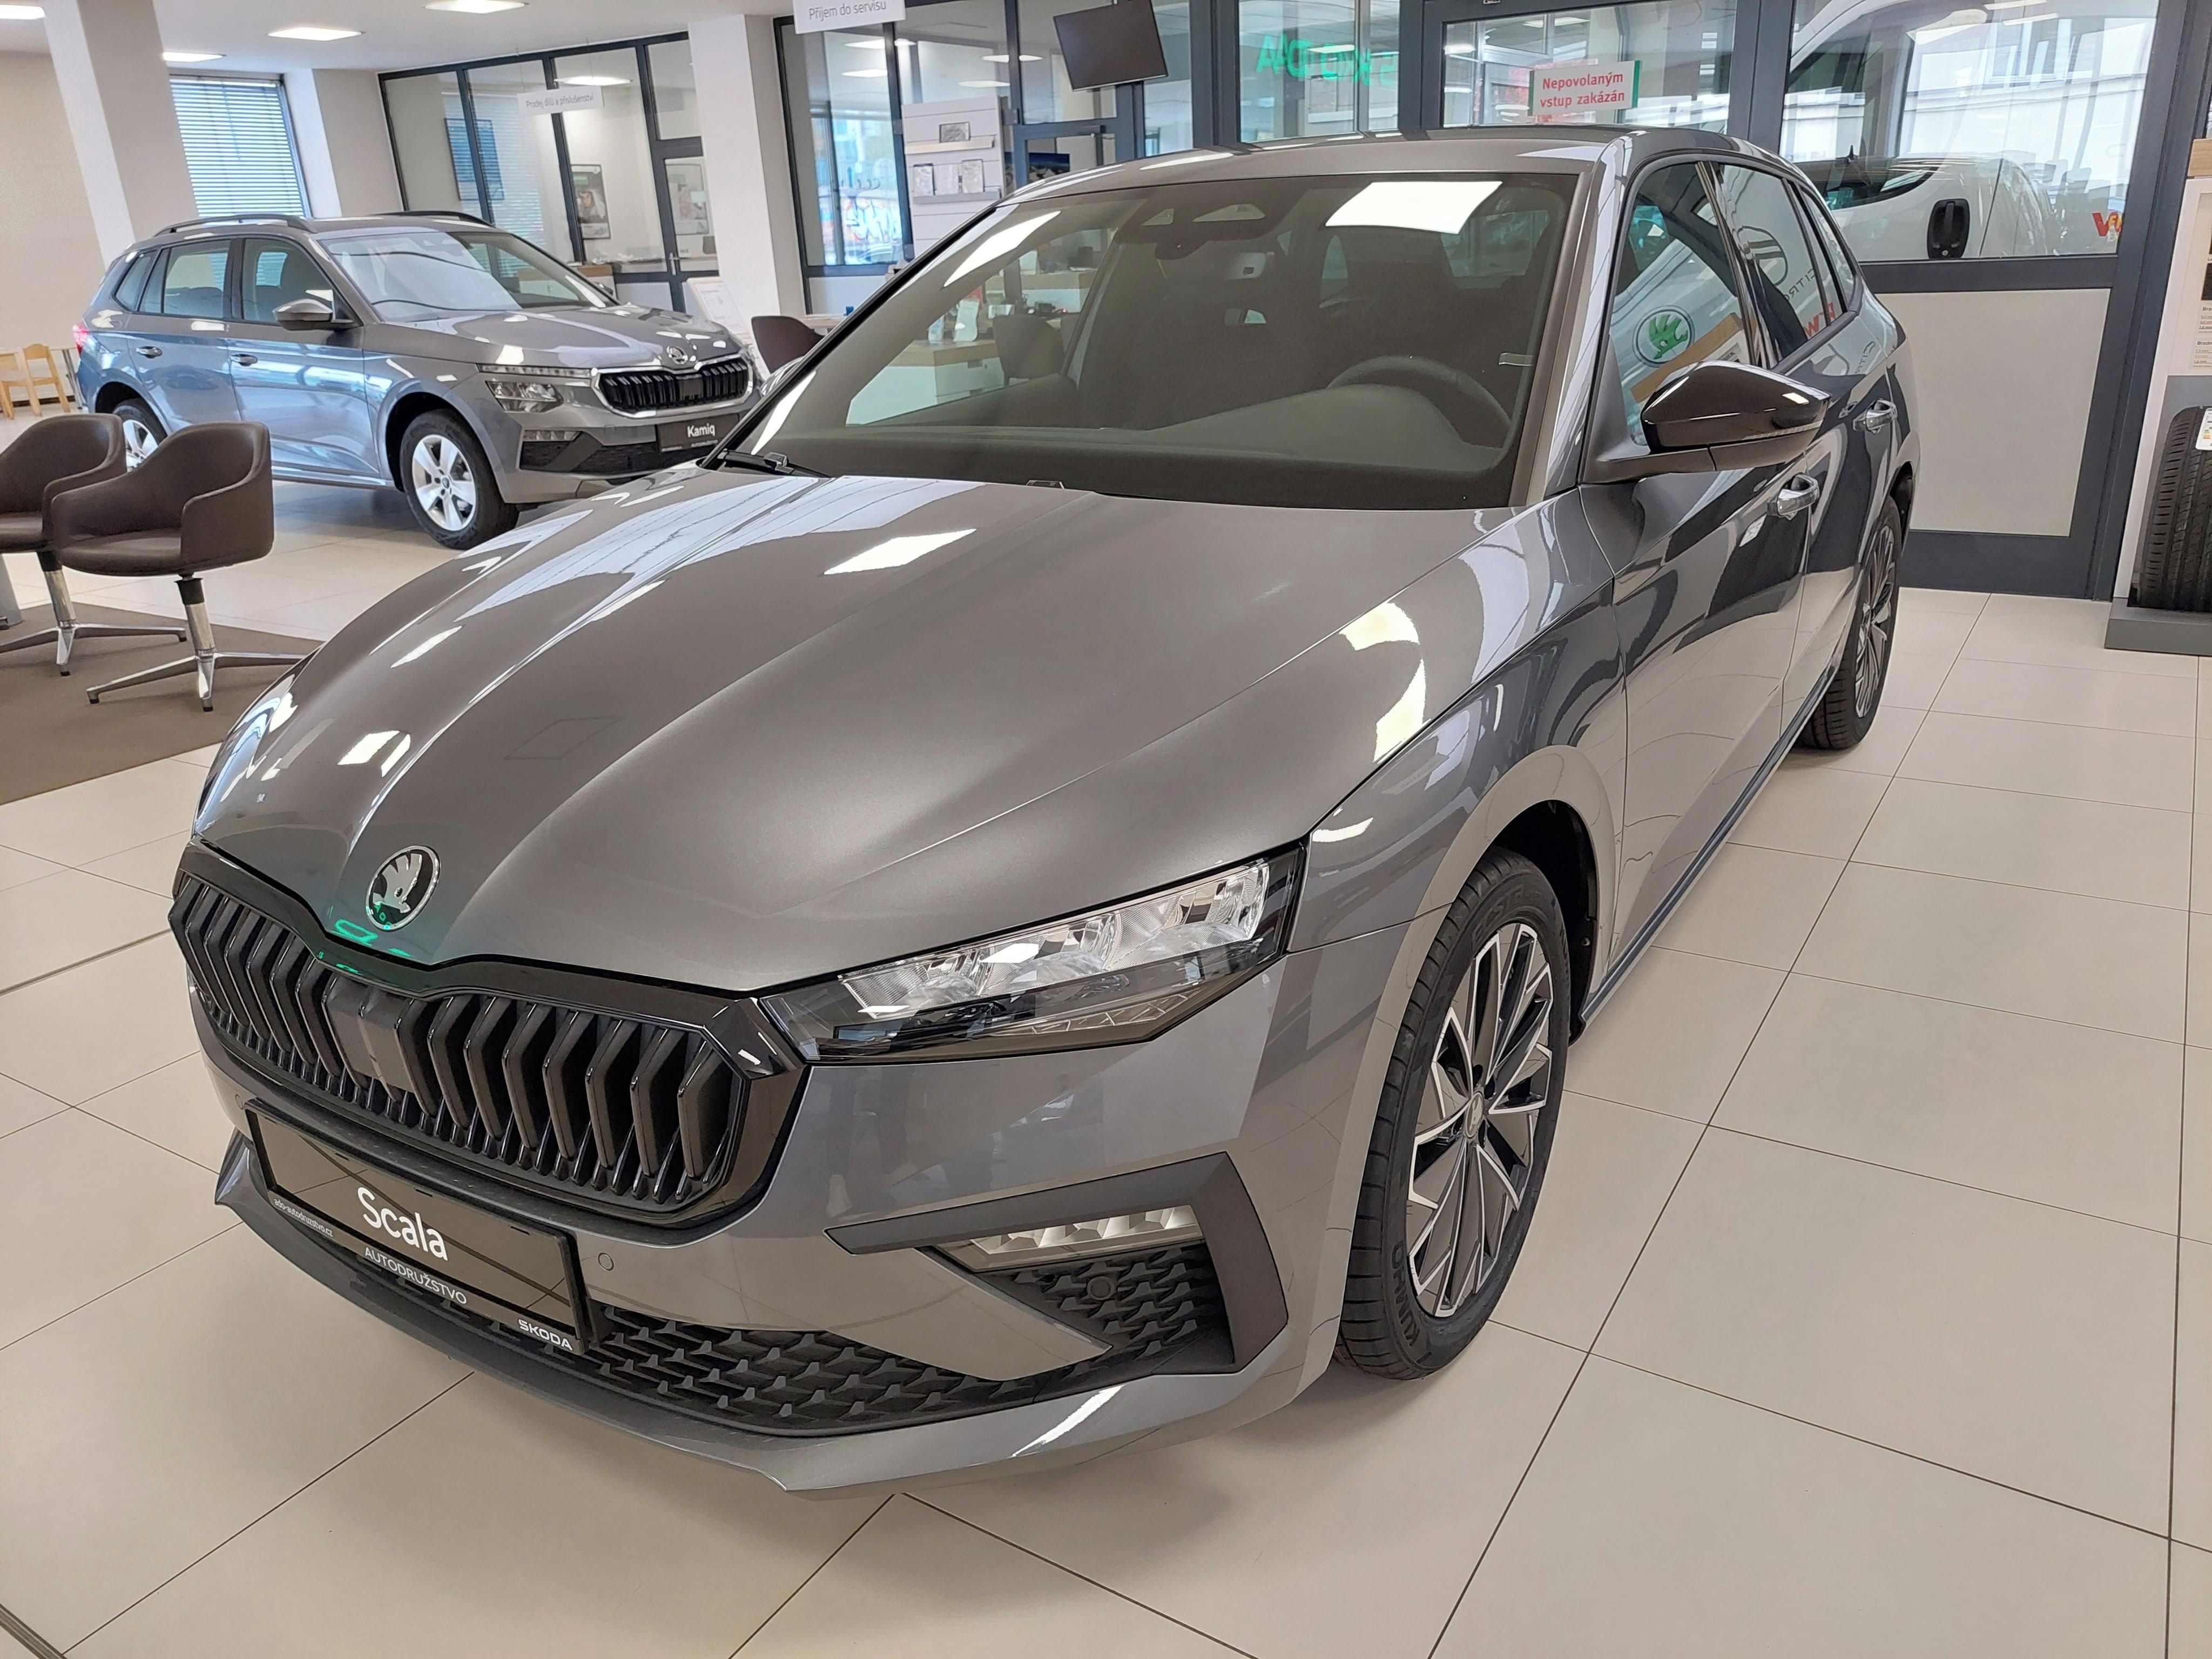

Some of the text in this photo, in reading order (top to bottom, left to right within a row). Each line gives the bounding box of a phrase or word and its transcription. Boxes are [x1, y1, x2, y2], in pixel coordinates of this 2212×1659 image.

[808, 1, 887, 22] Příjem do servisu
[1542, 72, 1623, 91] Nepovolaným
[1540, 90, 1625, 109] vstup zakázán
[687, 422, 716, 438] Kamiq
[274, 1198, 334, 1238] ado-autodruzstvo.cz
[357, 1186, 448, 1262] Scala
[365, 1246, 467, 1305] AUTODRUŽSTVO
